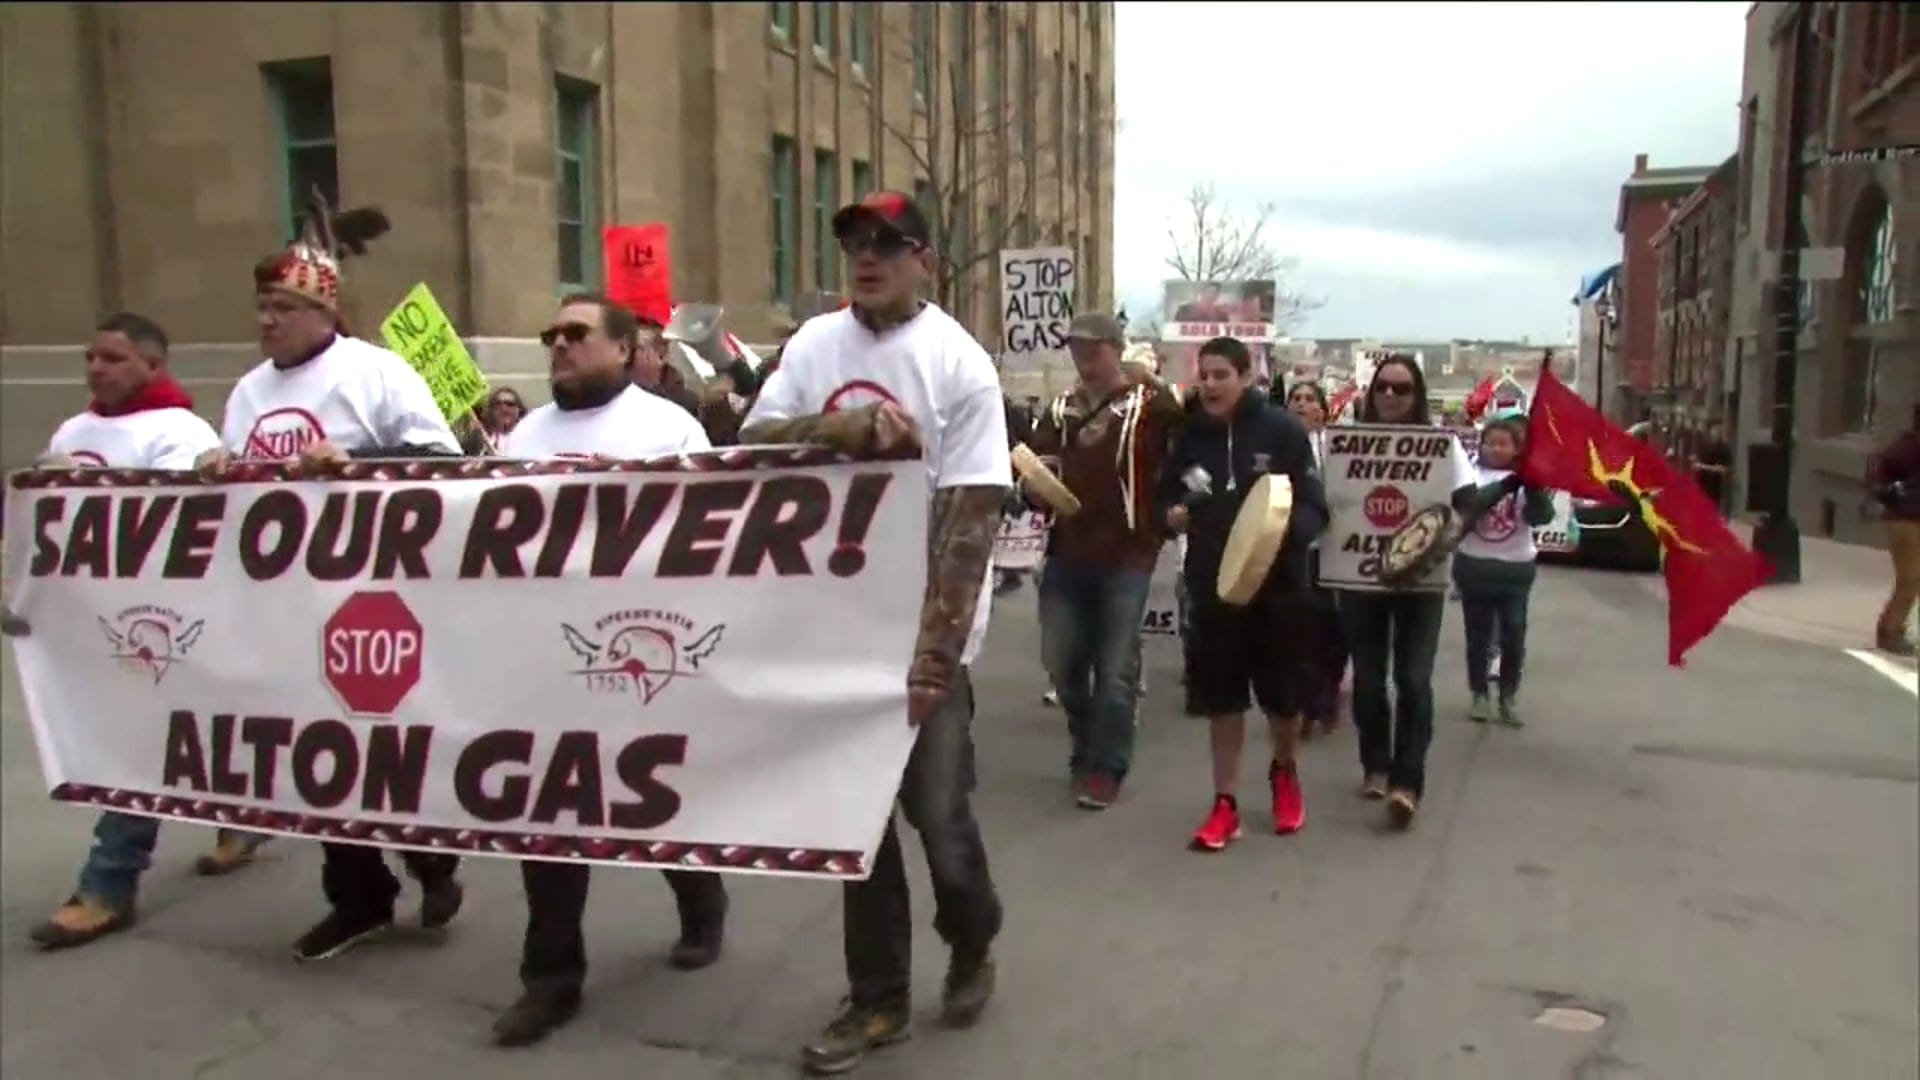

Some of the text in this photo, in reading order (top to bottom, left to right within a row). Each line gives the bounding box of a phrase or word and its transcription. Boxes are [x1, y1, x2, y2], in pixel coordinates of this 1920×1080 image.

[1005, 258, 1073, 290] STOP
[1006, 290, 1073, 321] ALTON
[390, 301, 429, 349] NO
[1008, 321, 1066, 353] GAS
[1330, 434, 1450, 458] SAVE OUR
[1347, 459, 1433, 481] RIVER!
[1367, 498, 1406, 515] STOP
[30, 472, 893, 581] SAVE OUR RIVER!
[1341, 533, 1392, 554] ALT
[329, 628, 417, 676] STOP
[163, 709, 688, 830] ALTON GAS
